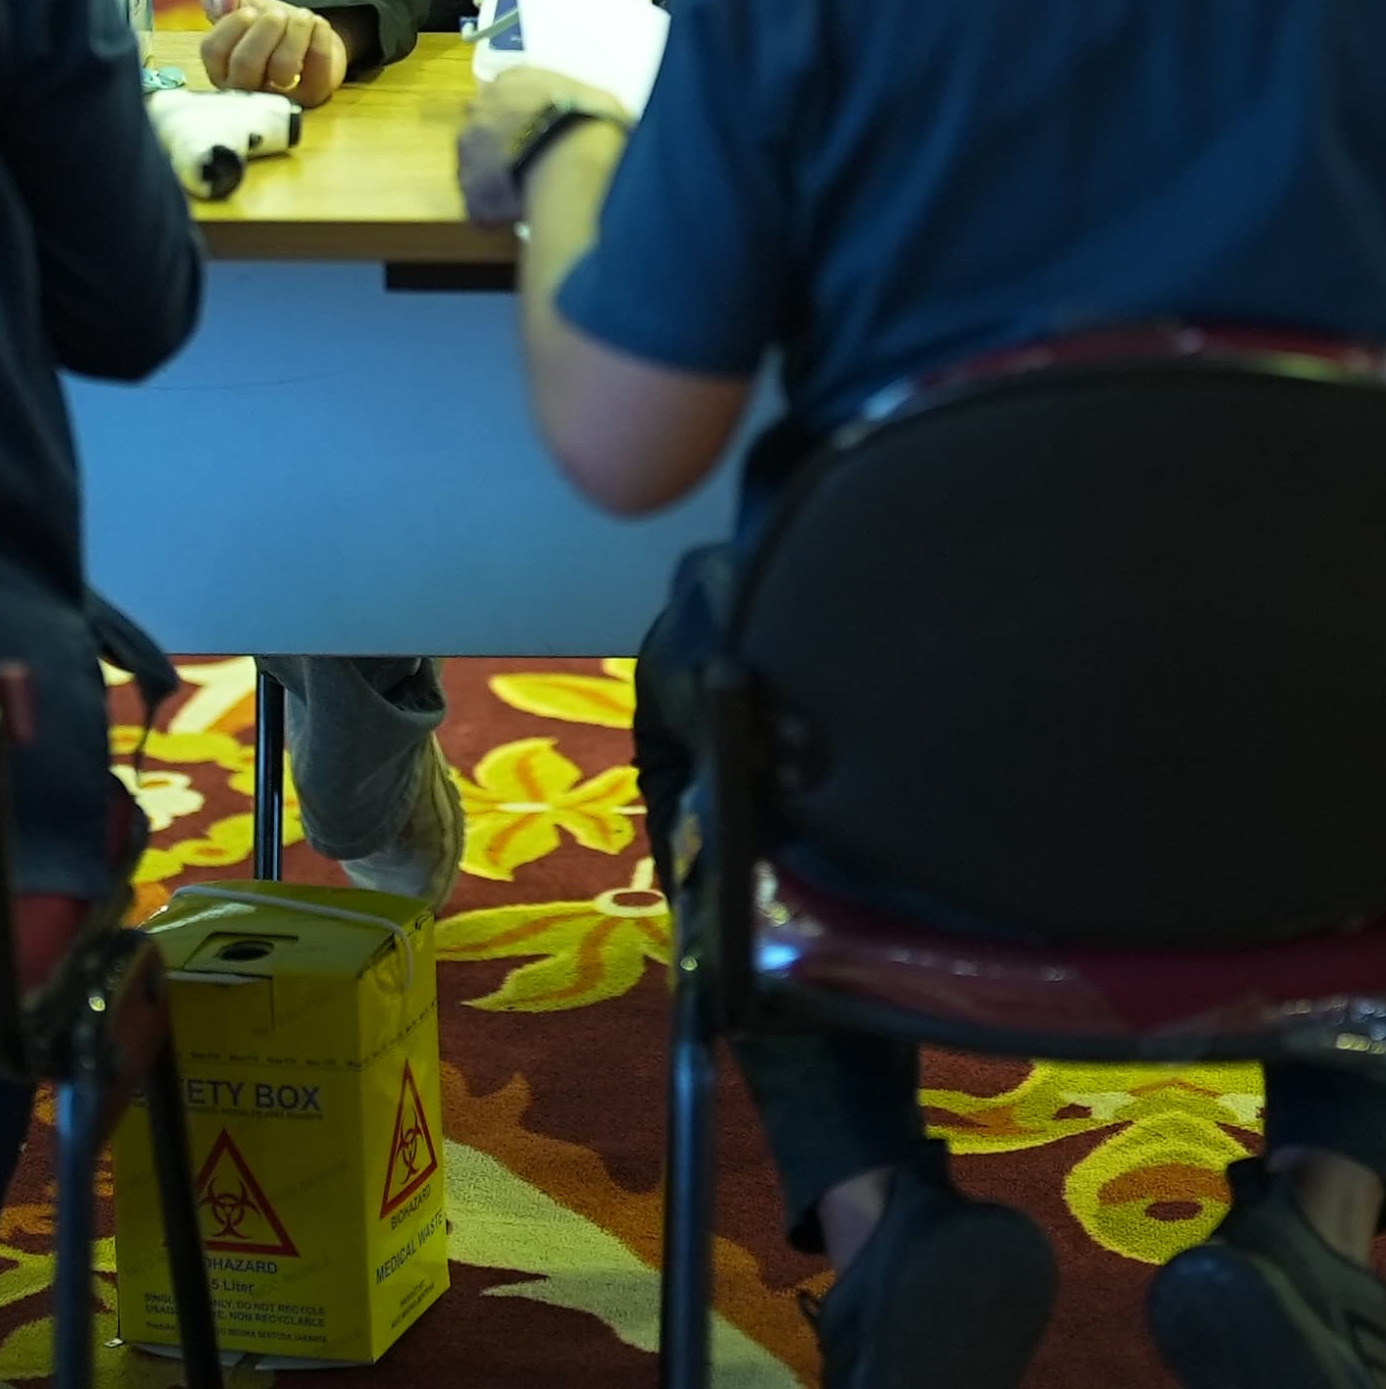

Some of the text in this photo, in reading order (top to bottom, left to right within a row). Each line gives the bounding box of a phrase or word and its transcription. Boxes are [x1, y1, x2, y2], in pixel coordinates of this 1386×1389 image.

[254, 1083, 321, 1111] BOX
[391, 1184, 431, 1231] BIOHAZARD
[376, 1209, 443, 1285] MEDICAL WASTE
[223, 1280, 254, 1293] Liter
